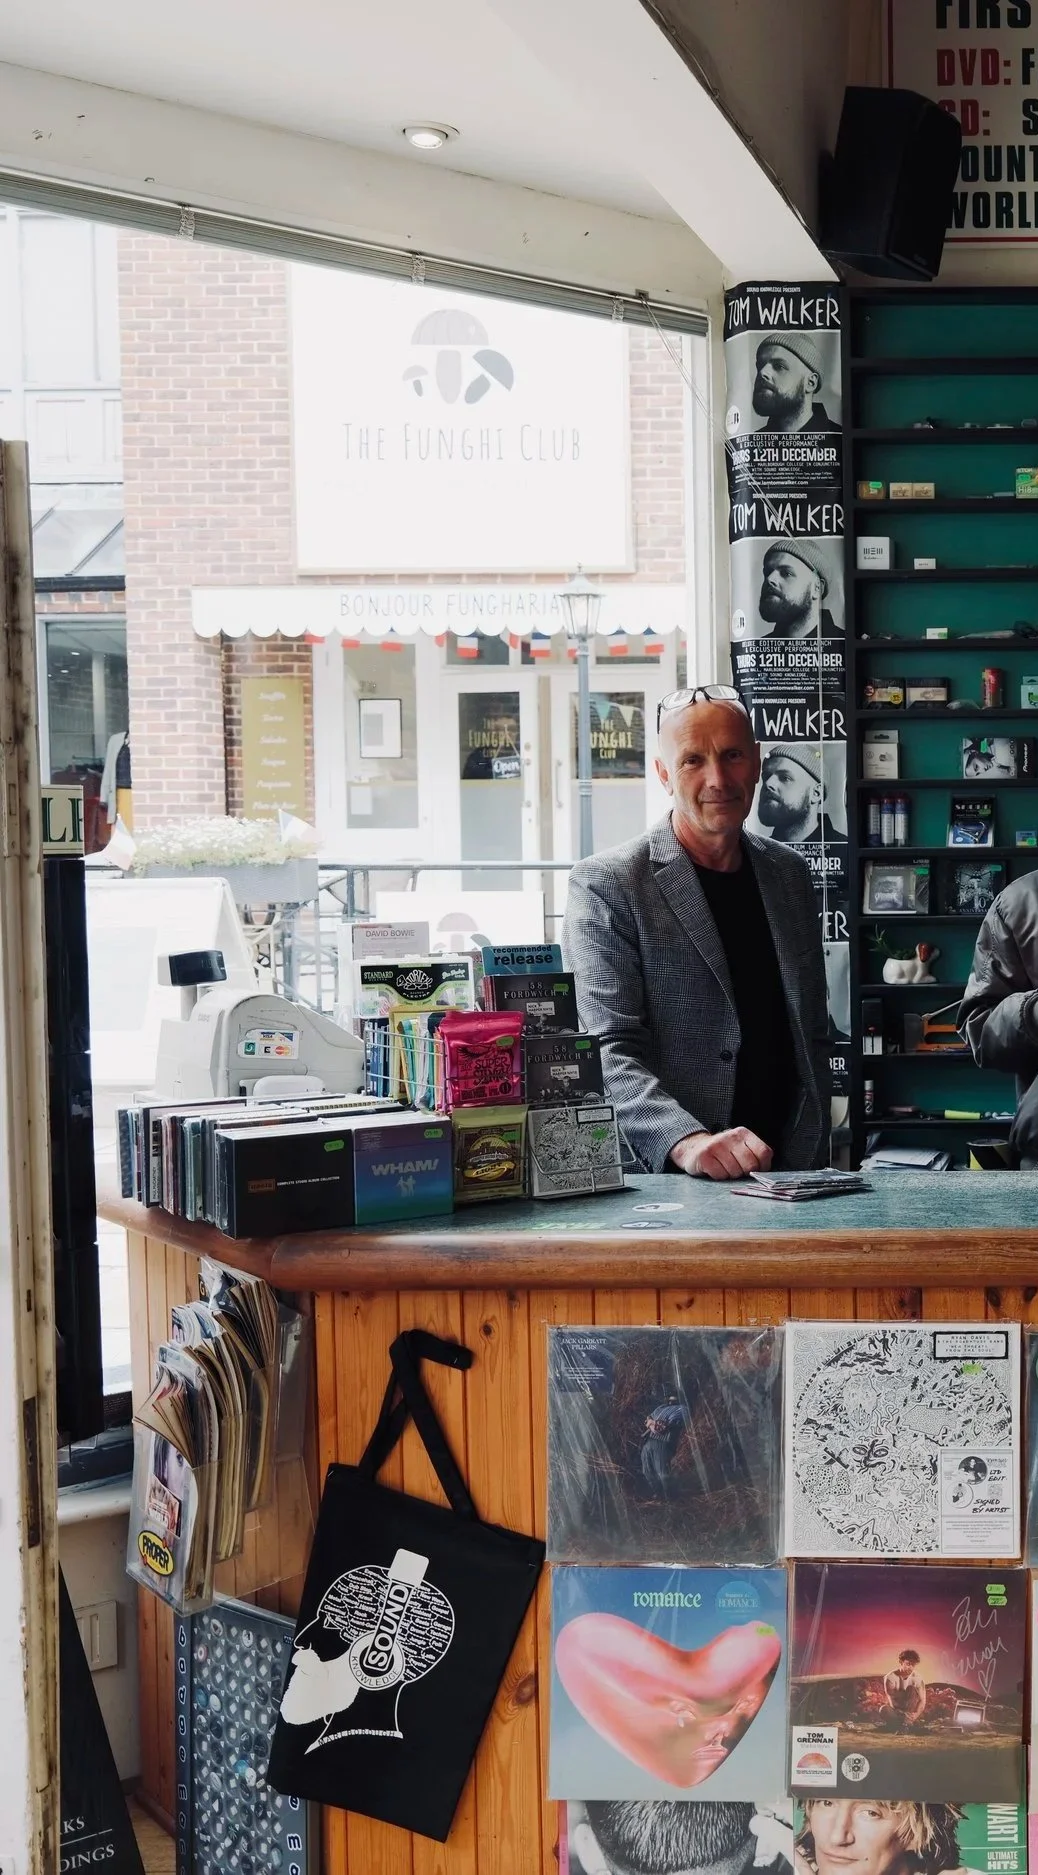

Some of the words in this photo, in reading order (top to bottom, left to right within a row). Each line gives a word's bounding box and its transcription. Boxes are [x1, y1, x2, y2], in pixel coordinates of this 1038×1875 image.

[937, 48, 1011, 86] DVD:
[729, 297, 750, 330] TOM
[757, 296, 841, 326] WALKER
[343, 423, 385, 461] THE
[404, 423, 504, 461] FUNGHI
[520, 423, 581, 461] CLUB
[753, 449, 779, 462] 12TH
[782, 448, 837, 461] DECEMBER
[732, 503, 756, 532] TOM
[763, 502, 845, 533] WALKER
[340, 594, 434, 616] BONJOUR
[759, 654, 785, 667] 12TH
[601, 719, 615, 731] THE
[762, 708, 847, 738] WALKER
[590, 731, 633, 748] UNGHI
[600, 748, 617, 759] CLUB
[493, 760, 520, 776] Open
[366, 930, 389, 938] DAVID
[391, 929, 416, 937] BOWIE
[493, 945, 552, 953] recommended
[494, 953, 553, 966] release
[363, 971, 394, 979] STANDARD
[503, 989, 557, 999] FORDWYCH
[475, 1057, 508, 1071] SUPER
[527, 1052, 581, 1063] FORDWYCH
[371, 1158, 440, 1177] WHAM!
[142, 1534, 170, 1572] PROPER
[633, 1591, 702, 1608] romance
[367, 1584, 412, 1668] SOUND
[351, 1655, 400, 1687] KNOWLEDGE
[318, 1729, 396, 1746] MARLBOROUGH
[987, 1803, 1019, 1844] WART
[987, 1851, 1019, 1860] ULTIMATE
[987, 1860, 1019, 1871] HITS
